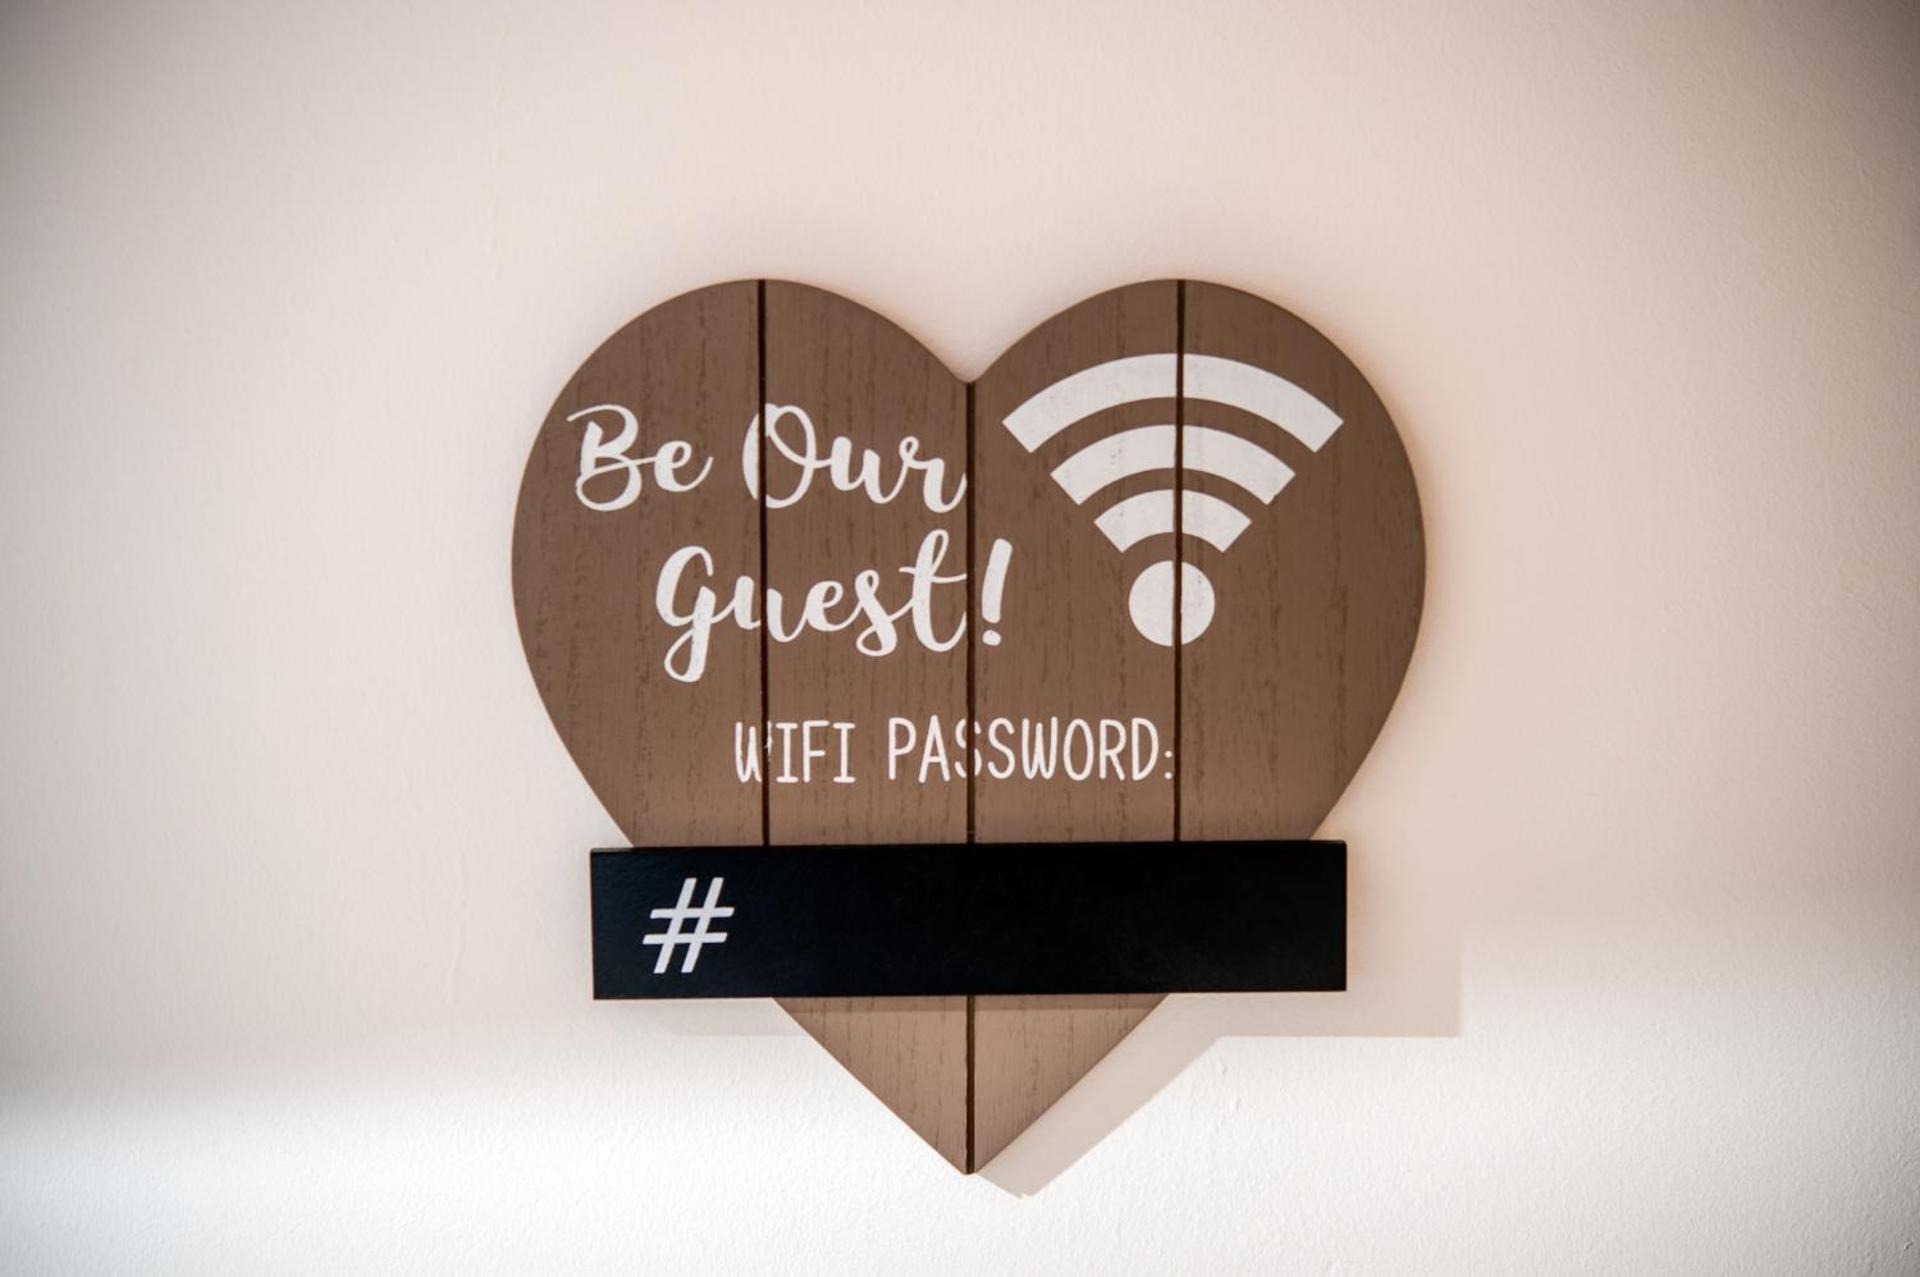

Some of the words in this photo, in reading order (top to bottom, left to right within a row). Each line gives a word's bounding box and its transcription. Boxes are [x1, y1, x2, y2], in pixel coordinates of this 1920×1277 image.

[566, 404, 714, 512] Be
[742, 403, 967, 514] Our
[655, 528, 1013, 683] Guest!
[734, 719, 856, 784] WIFI
[888, 715, 1174, 784] PASSWORD:
[642, 877, 734, 974] #
